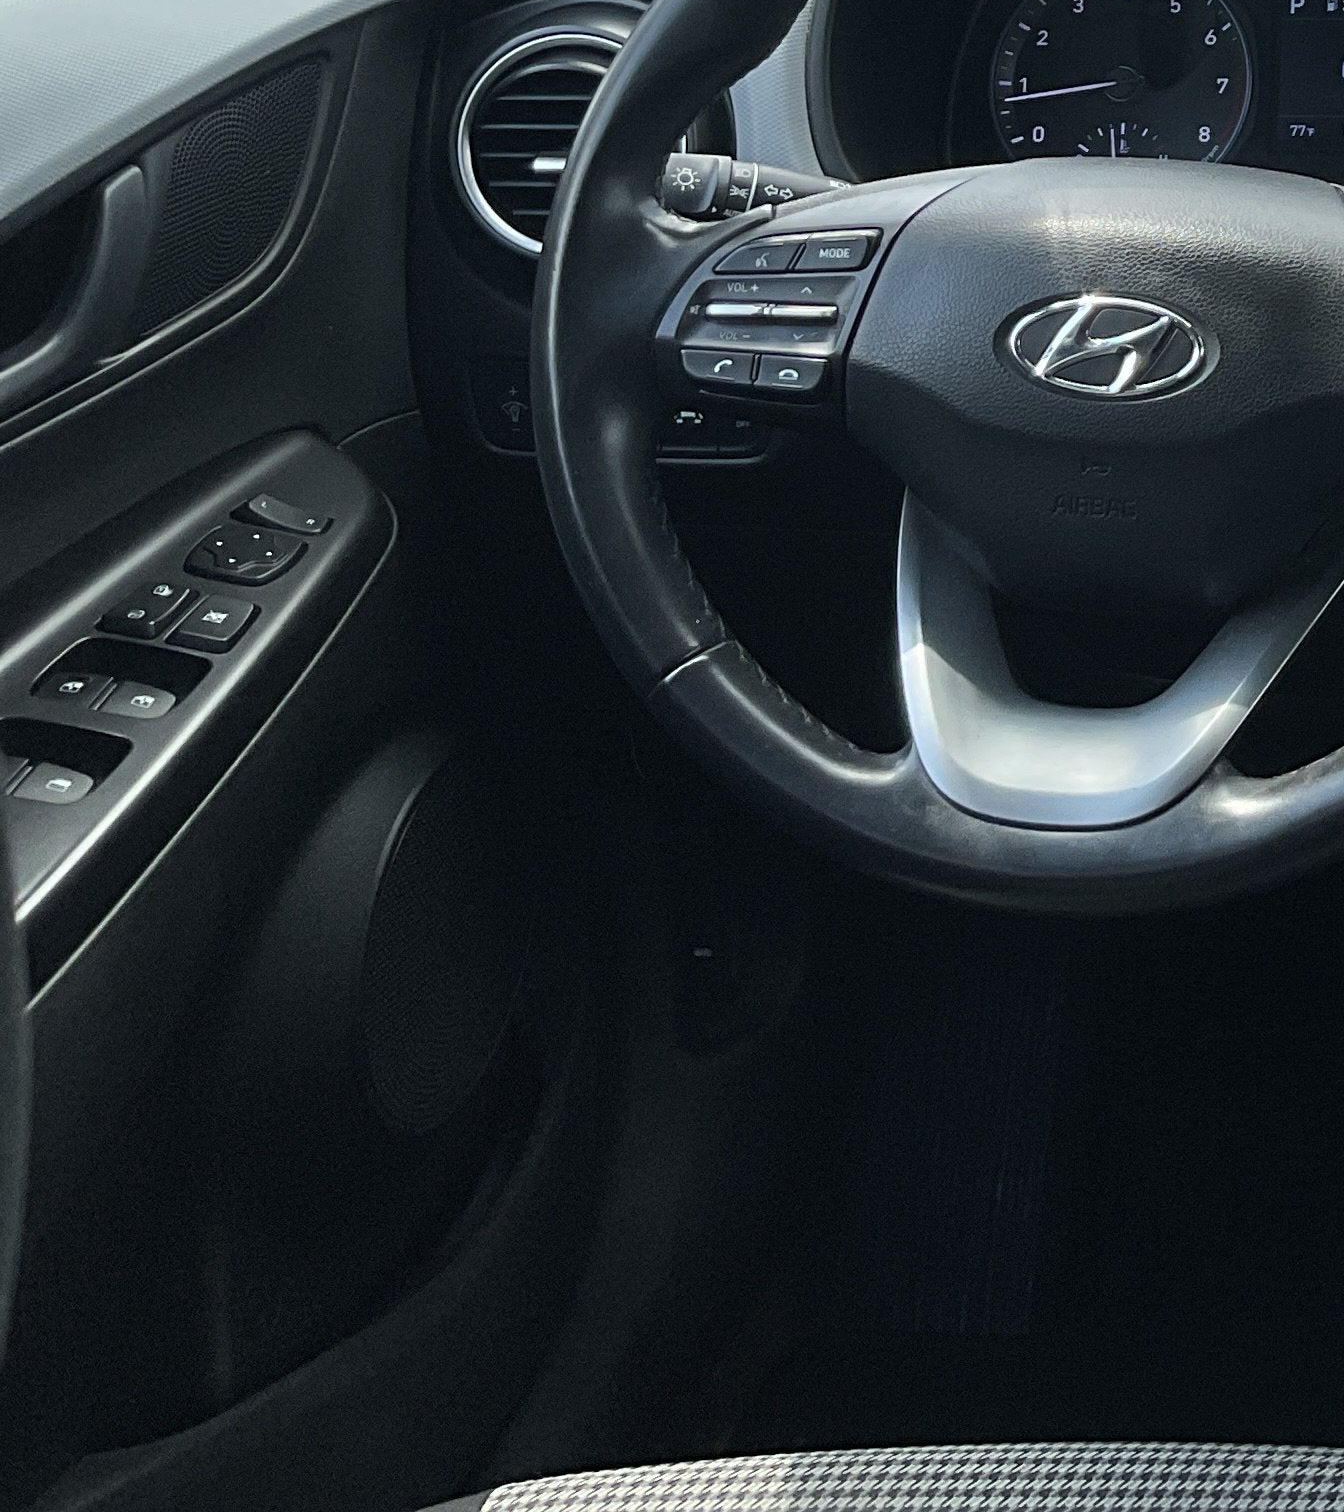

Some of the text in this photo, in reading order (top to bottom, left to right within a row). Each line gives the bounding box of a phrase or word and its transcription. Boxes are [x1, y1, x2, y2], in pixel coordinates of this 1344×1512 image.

[1036, 30, 1049, 46] 2
[1204, 29, 1217, 45] 6
[1018, 77, 1028, 92] 1
[1217, 78, 1229, 94] 7
[1032, 126, 1045, 142] 0
[1198, 126, 1211, 143] 8
[819, 248, 850, 259] MODE
[727, 283, 747, 293] VOL
